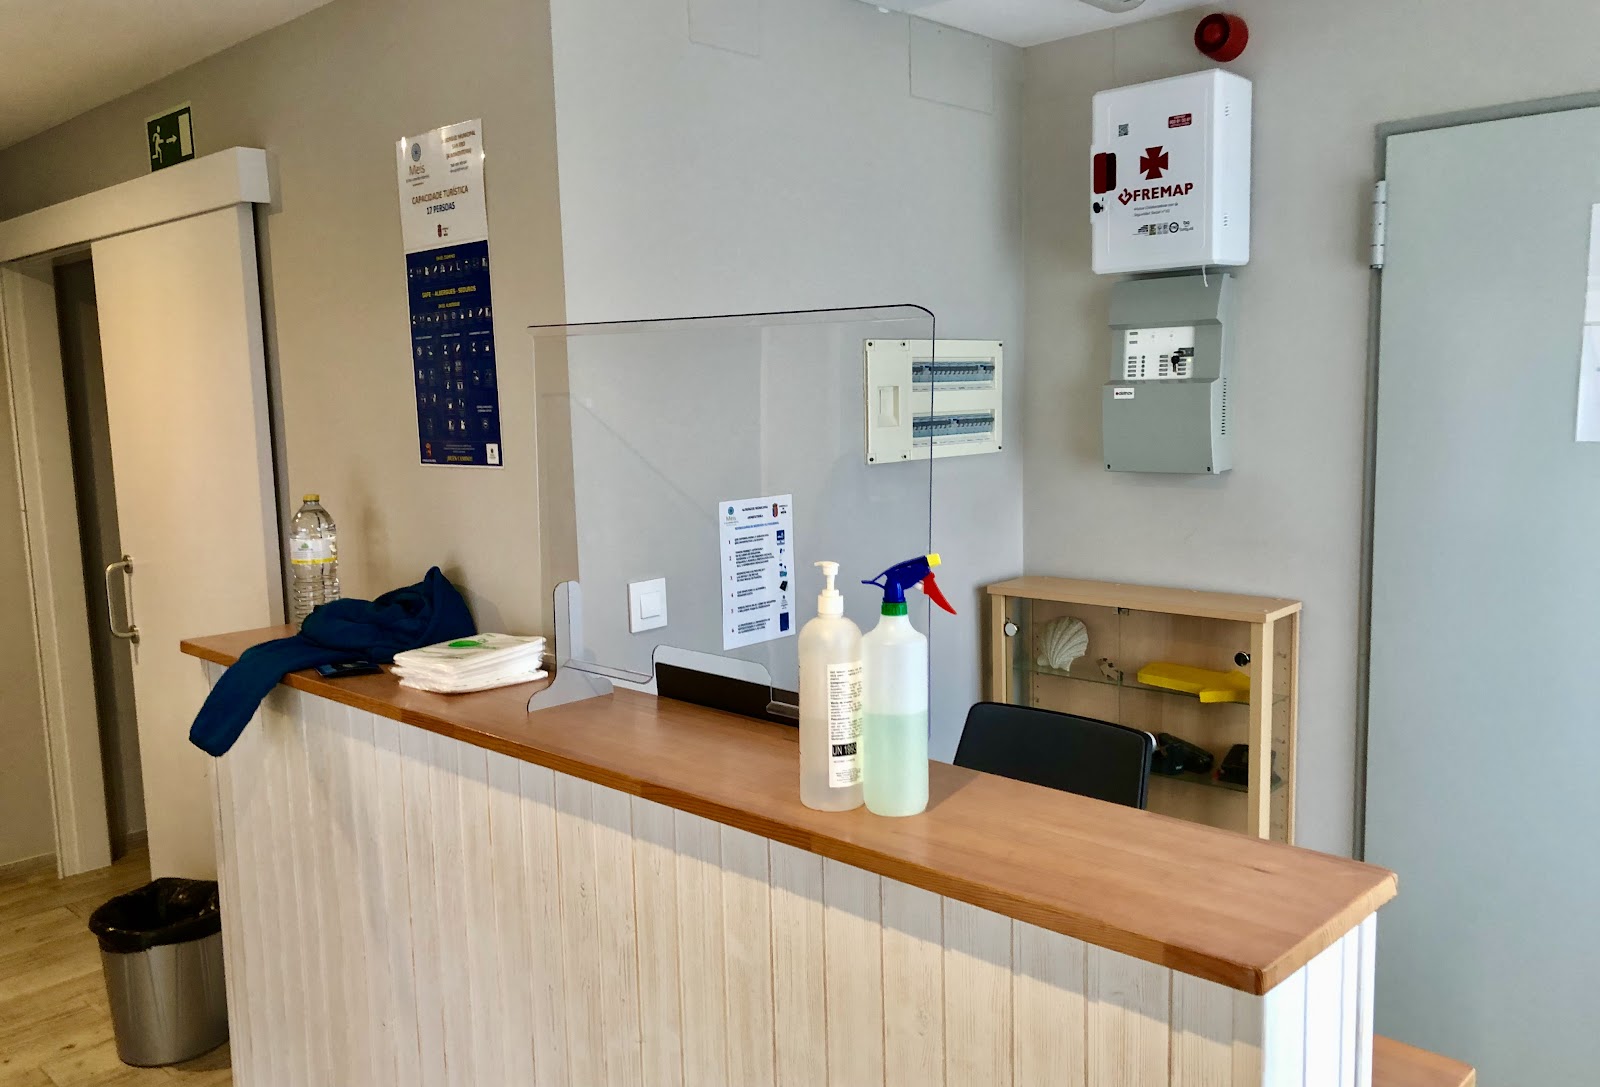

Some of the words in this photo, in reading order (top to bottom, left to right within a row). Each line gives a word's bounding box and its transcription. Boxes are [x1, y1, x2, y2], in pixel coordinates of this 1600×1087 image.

[412, 190, 442, 205] CAPACIDADE
[443, 184, 468, 198] TURÍSTICA
[1133, 182, 1194, 202] FREMAP
[426, 206, 432, 215] 17
[433, 202, 456, 214] PERSOAS
